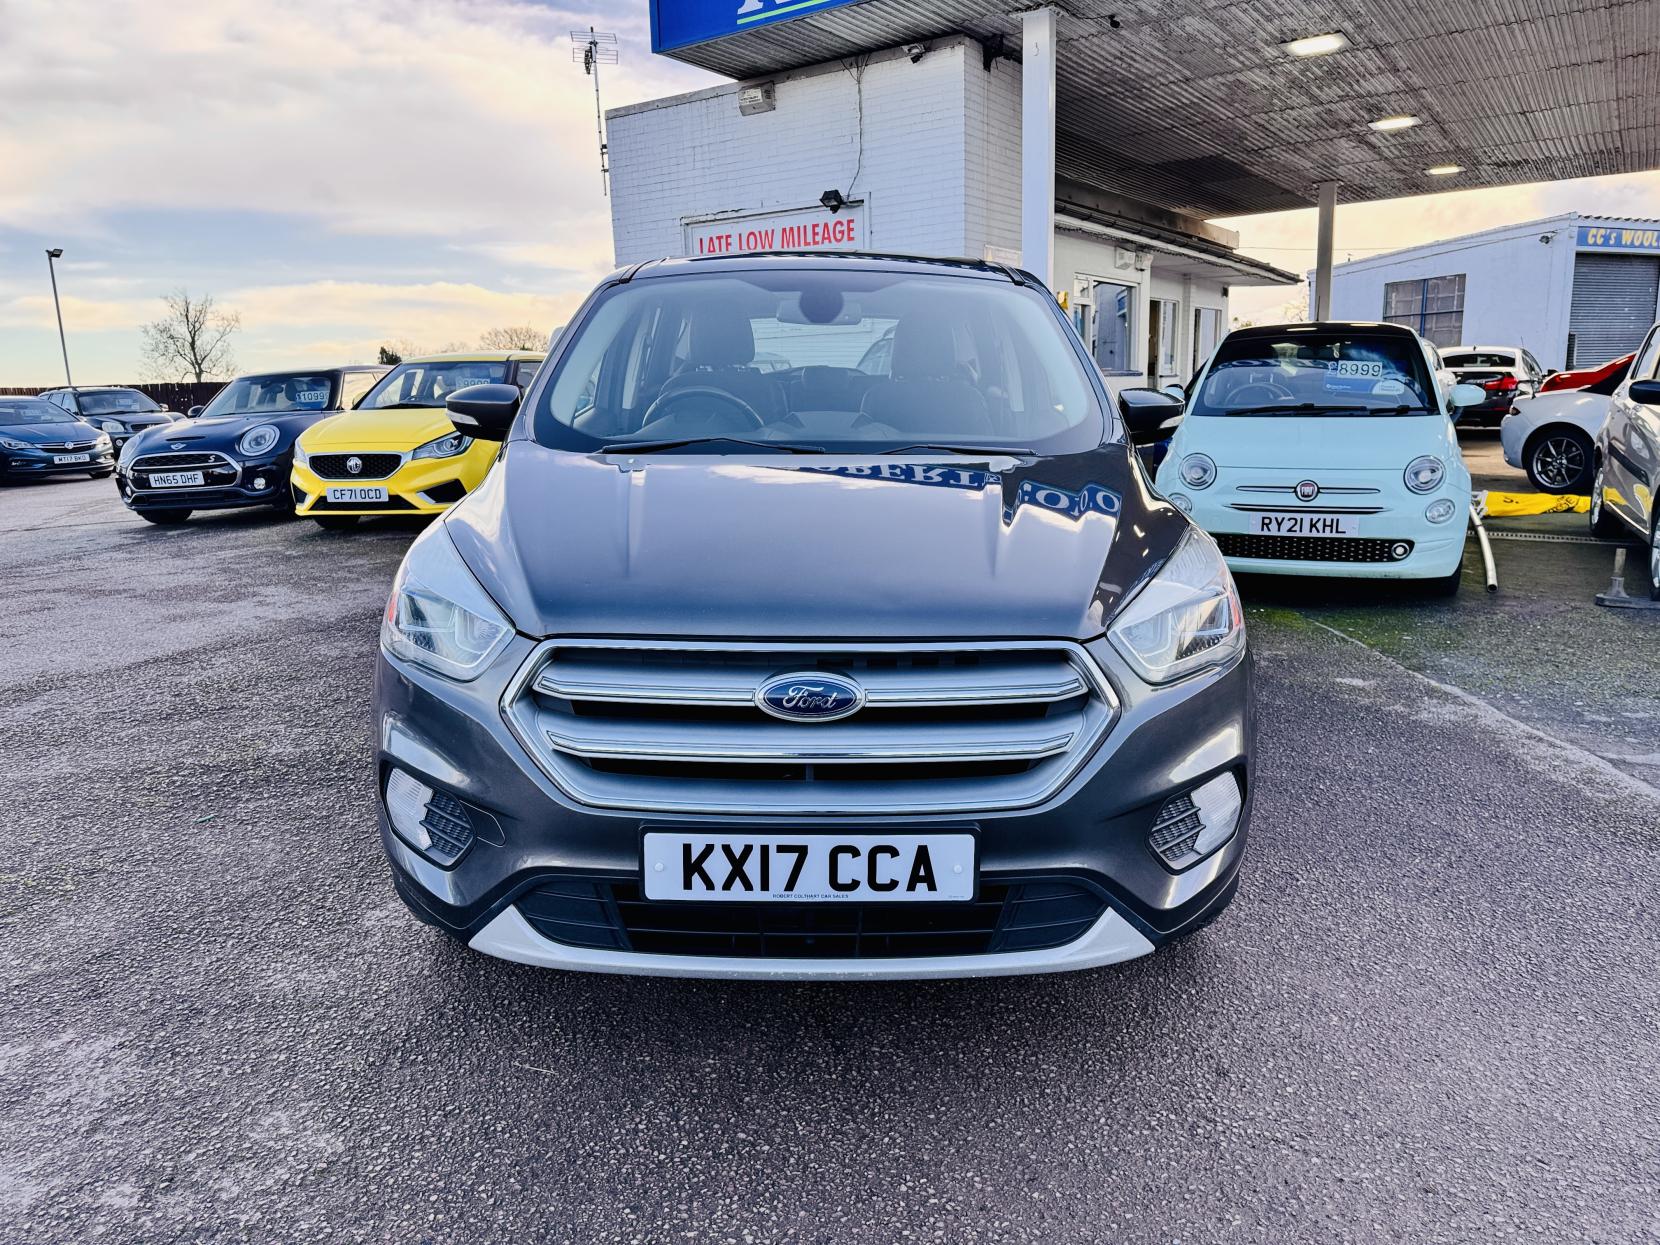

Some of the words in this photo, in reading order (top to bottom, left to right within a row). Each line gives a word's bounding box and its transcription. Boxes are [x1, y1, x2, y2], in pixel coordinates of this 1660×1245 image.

[699, 234, 732, 254] LATE
[738, 229, 775, 251] LOW
[781, 219, 855, 249] MILEAGE
[1621, 229, 1660, 247] WOOL
[153, 475, 179, 485] HN65
[181, 473, 199, 482] DHF
[333, 489, 357, 500] CF71
[360, 488, 381, 500] OCD
[1260, 516, 1303, 533] RY21
[1309, 517, 1346, 534] KHL
[782, 685, 838, 709] Ford
[682, 843, 809, 892] KX17
[828, 844, 937, 892] CCA
